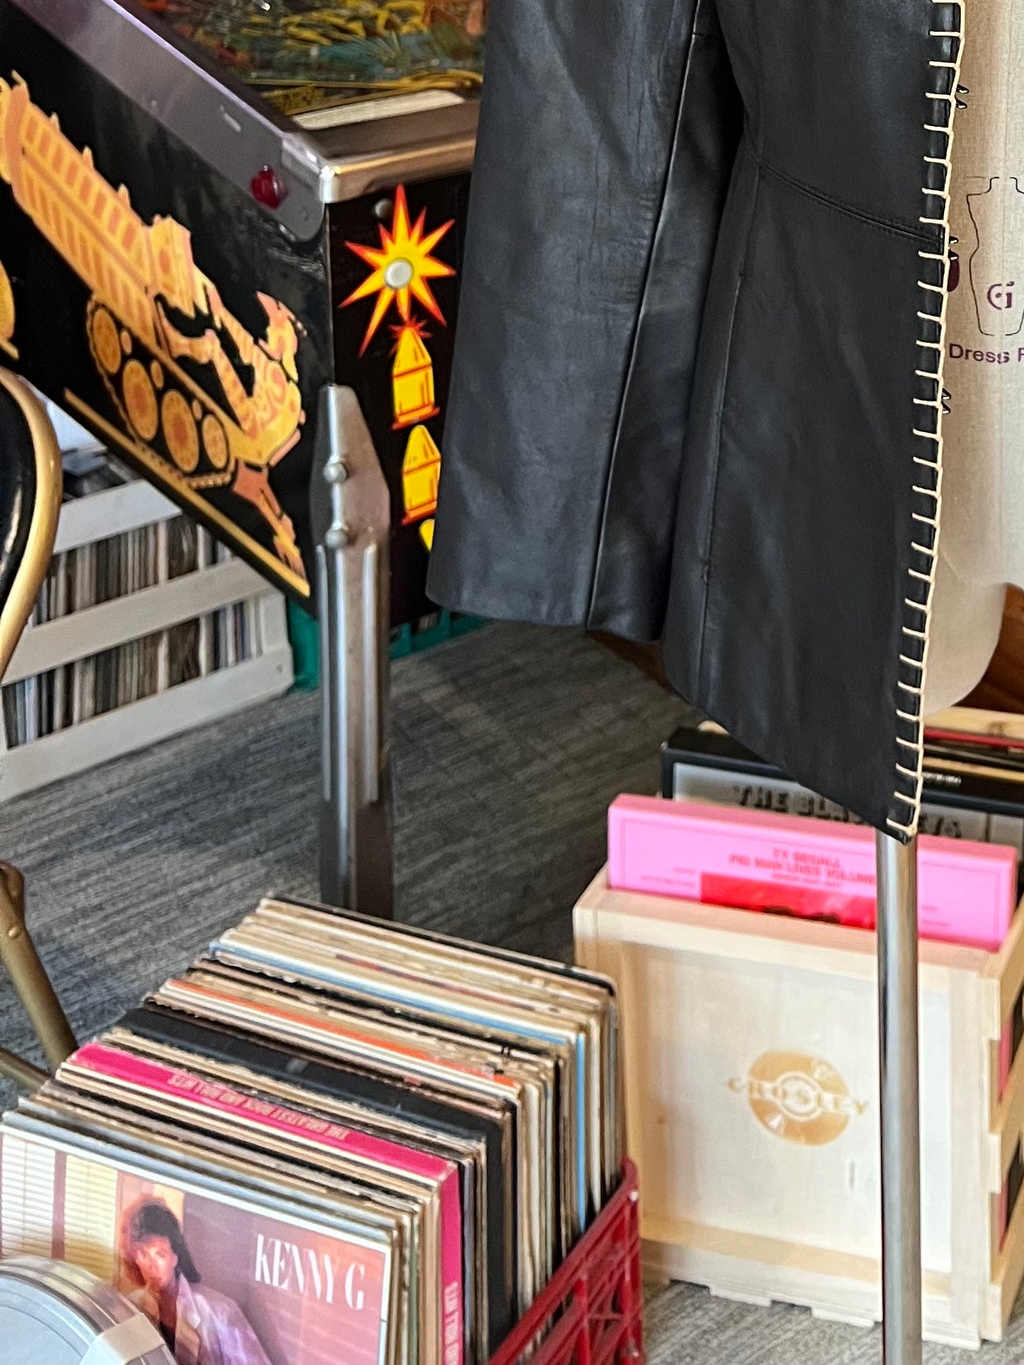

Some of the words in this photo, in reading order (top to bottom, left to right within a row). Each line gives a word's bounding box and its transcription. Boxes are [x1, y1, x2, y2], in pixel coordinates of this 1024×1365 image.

[949, 343, 1010, 364] Dress
[735, 784, 789, 812] THE
[254, 1233, 336, 1305] KENNY
[344, 1260, 366, 1311] G
